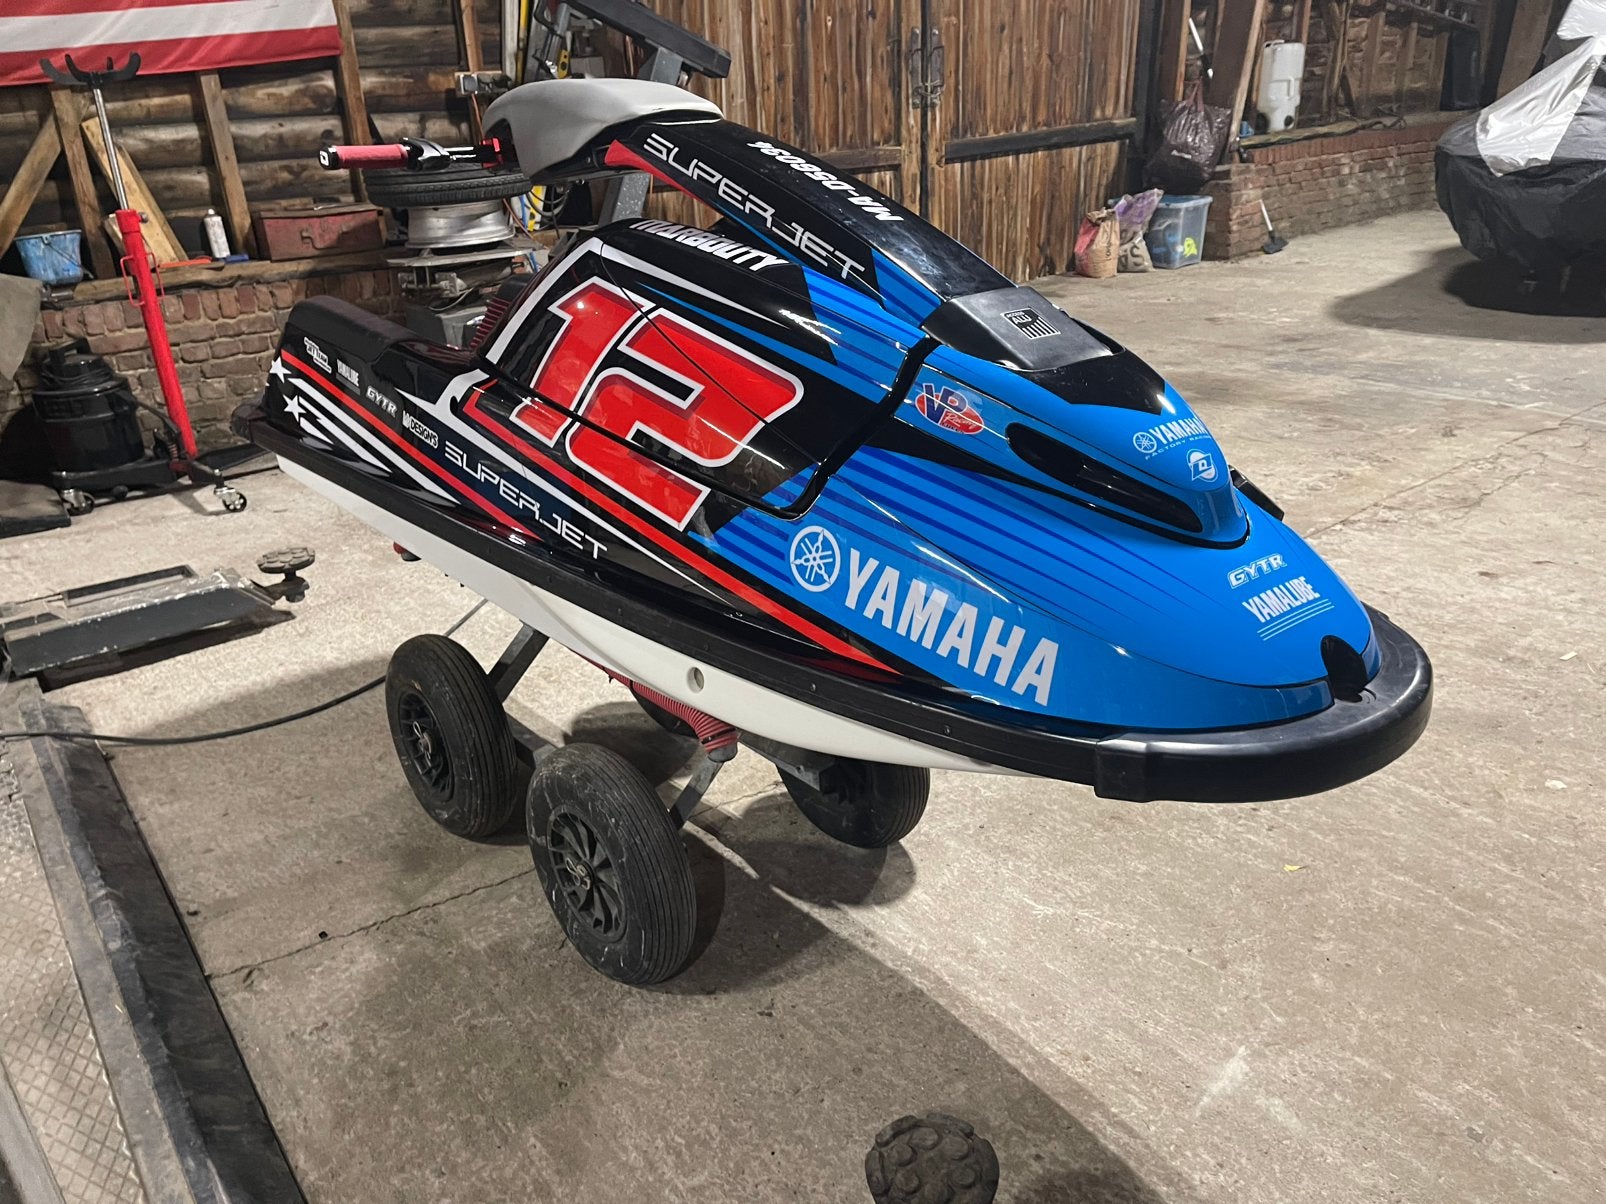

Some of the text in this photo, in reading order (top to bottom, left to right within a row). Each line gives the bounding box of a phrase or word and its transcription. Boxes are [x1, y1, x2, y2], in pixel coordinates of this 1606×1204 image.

[643, 132, 866, 280] SUPERJET
[629, 218, 790, 272] MARBOUTY
[366, 385, 398, 418] GYTR
[508, 275, 805, 533] 12
[922, 383, 968, 425] VP
[1144, 440, 1187, 461] FACTORY
[1148, 417, 1209, 445] YAMAHA
[444, 440, 608, 560] SUPERJET
[1227, 553, 1288, 590] GYTR
[1241, 576, 1321, 623] YAMALUBE
[844, 547, 1060, 707] YAMAHA
